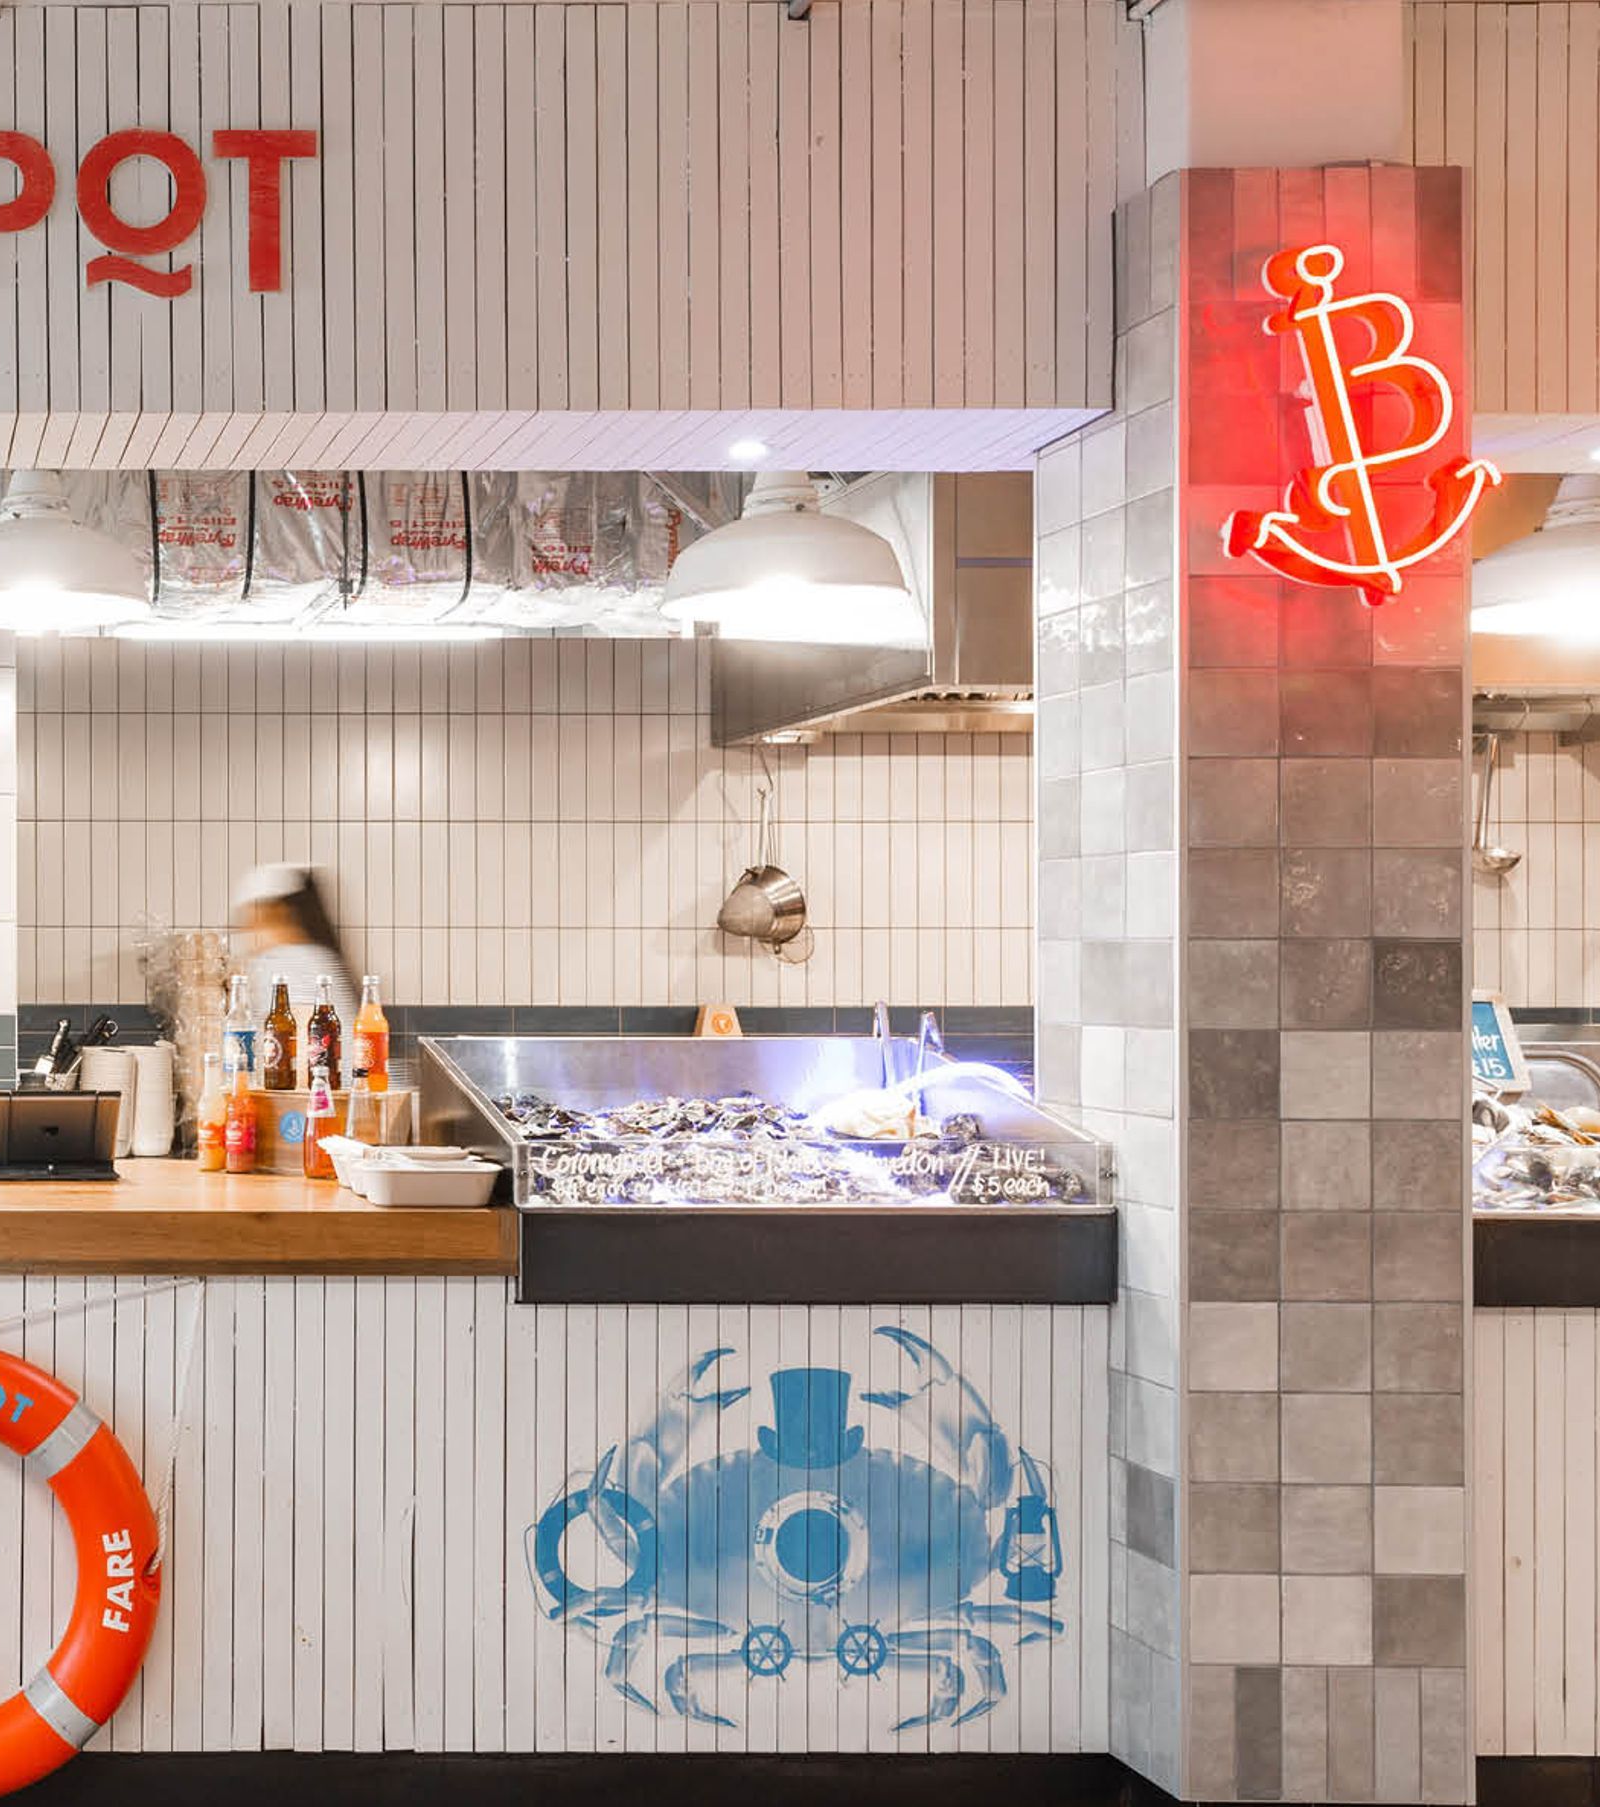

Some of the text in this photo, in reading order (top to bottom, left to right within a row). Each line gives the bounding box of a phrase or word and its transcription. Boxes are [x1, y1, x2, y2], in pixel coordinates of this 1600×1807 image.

[992, 1149, 1047, 1172] LIVE!
[1002, 1177, 1051, 1198] each
[102, 1528, 136, 1632] FARE
